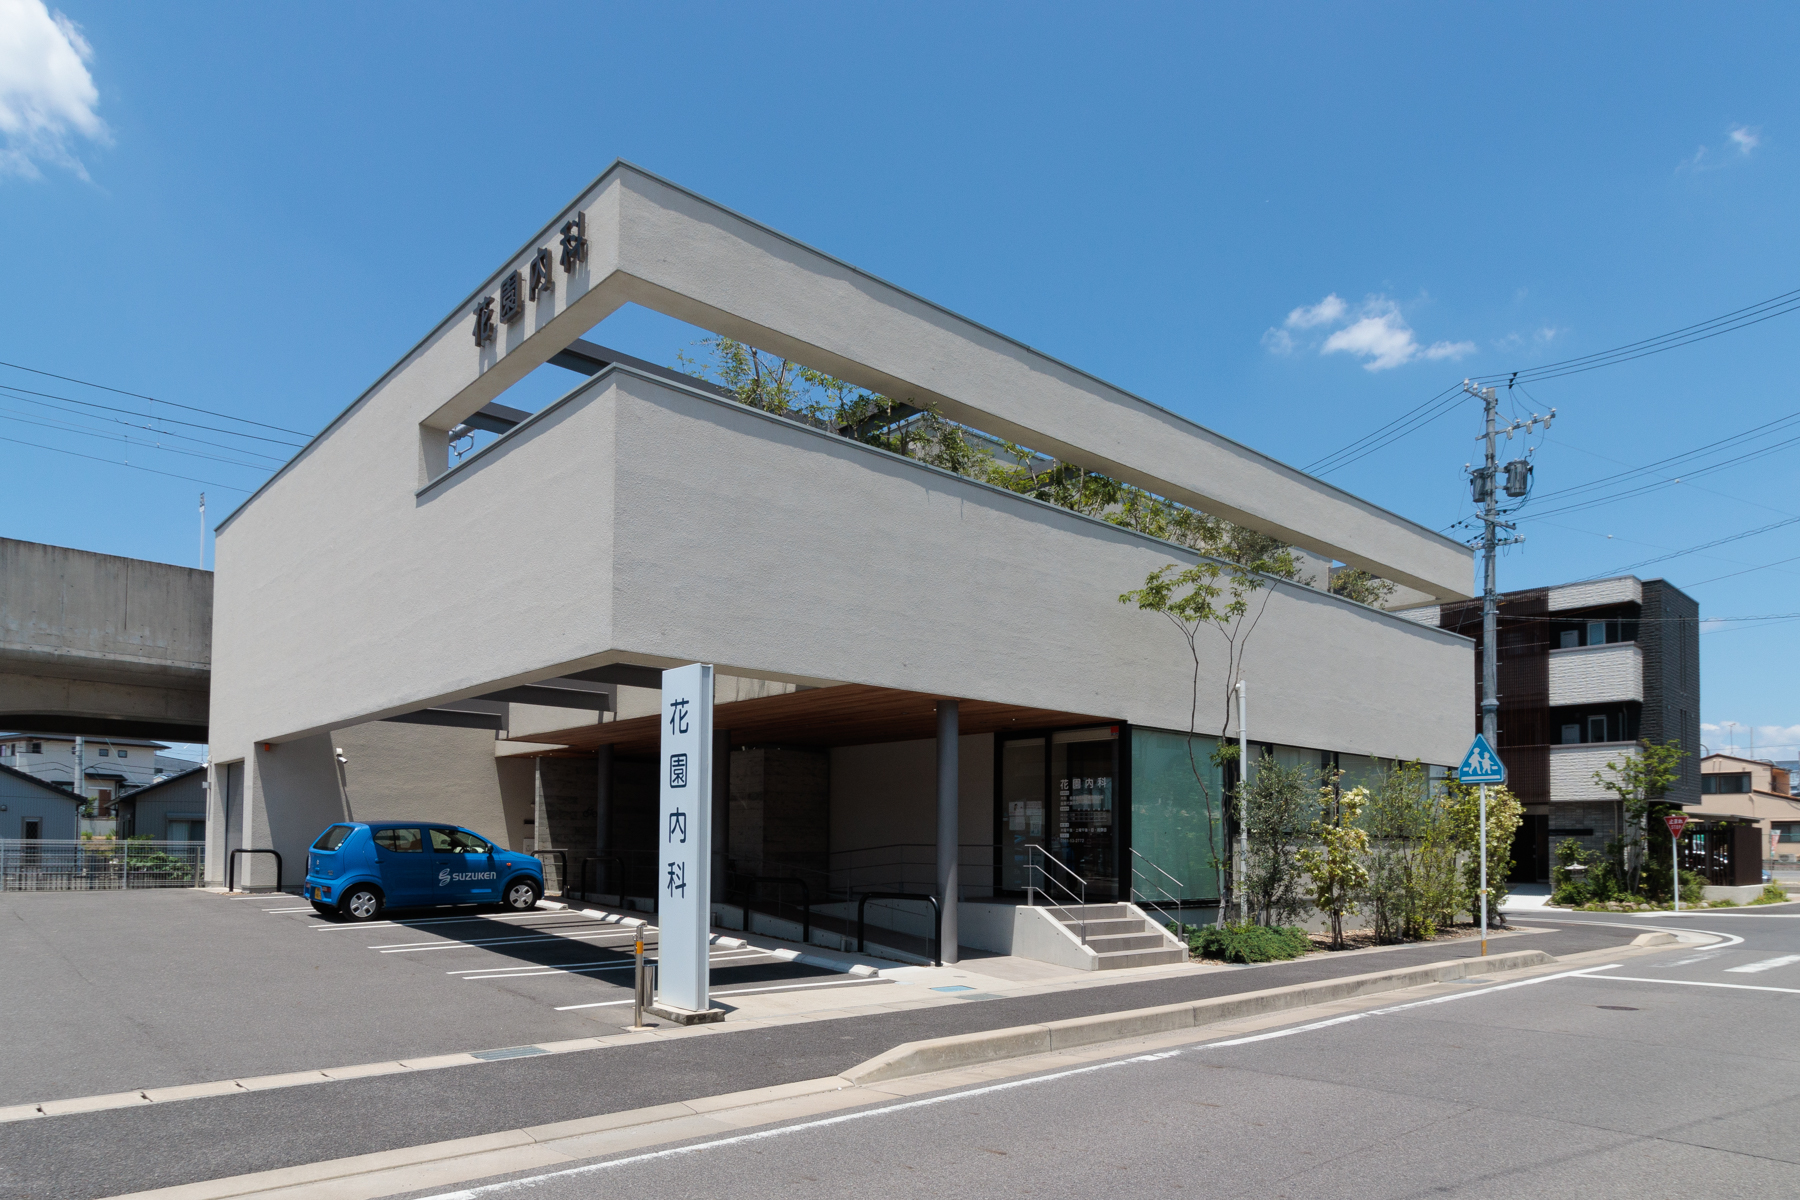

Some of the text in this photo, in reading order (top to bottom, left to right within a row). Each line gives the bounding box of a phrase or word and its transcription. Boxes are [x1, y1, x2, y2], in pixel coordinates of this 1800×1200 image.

[472, 210, 588, 348] 花園内科
[667, 697, 690, 899] 花園内科
[1060, 777, 1107, 790] 花園内科
[452, 871, 497, 881] SUZUKEN
